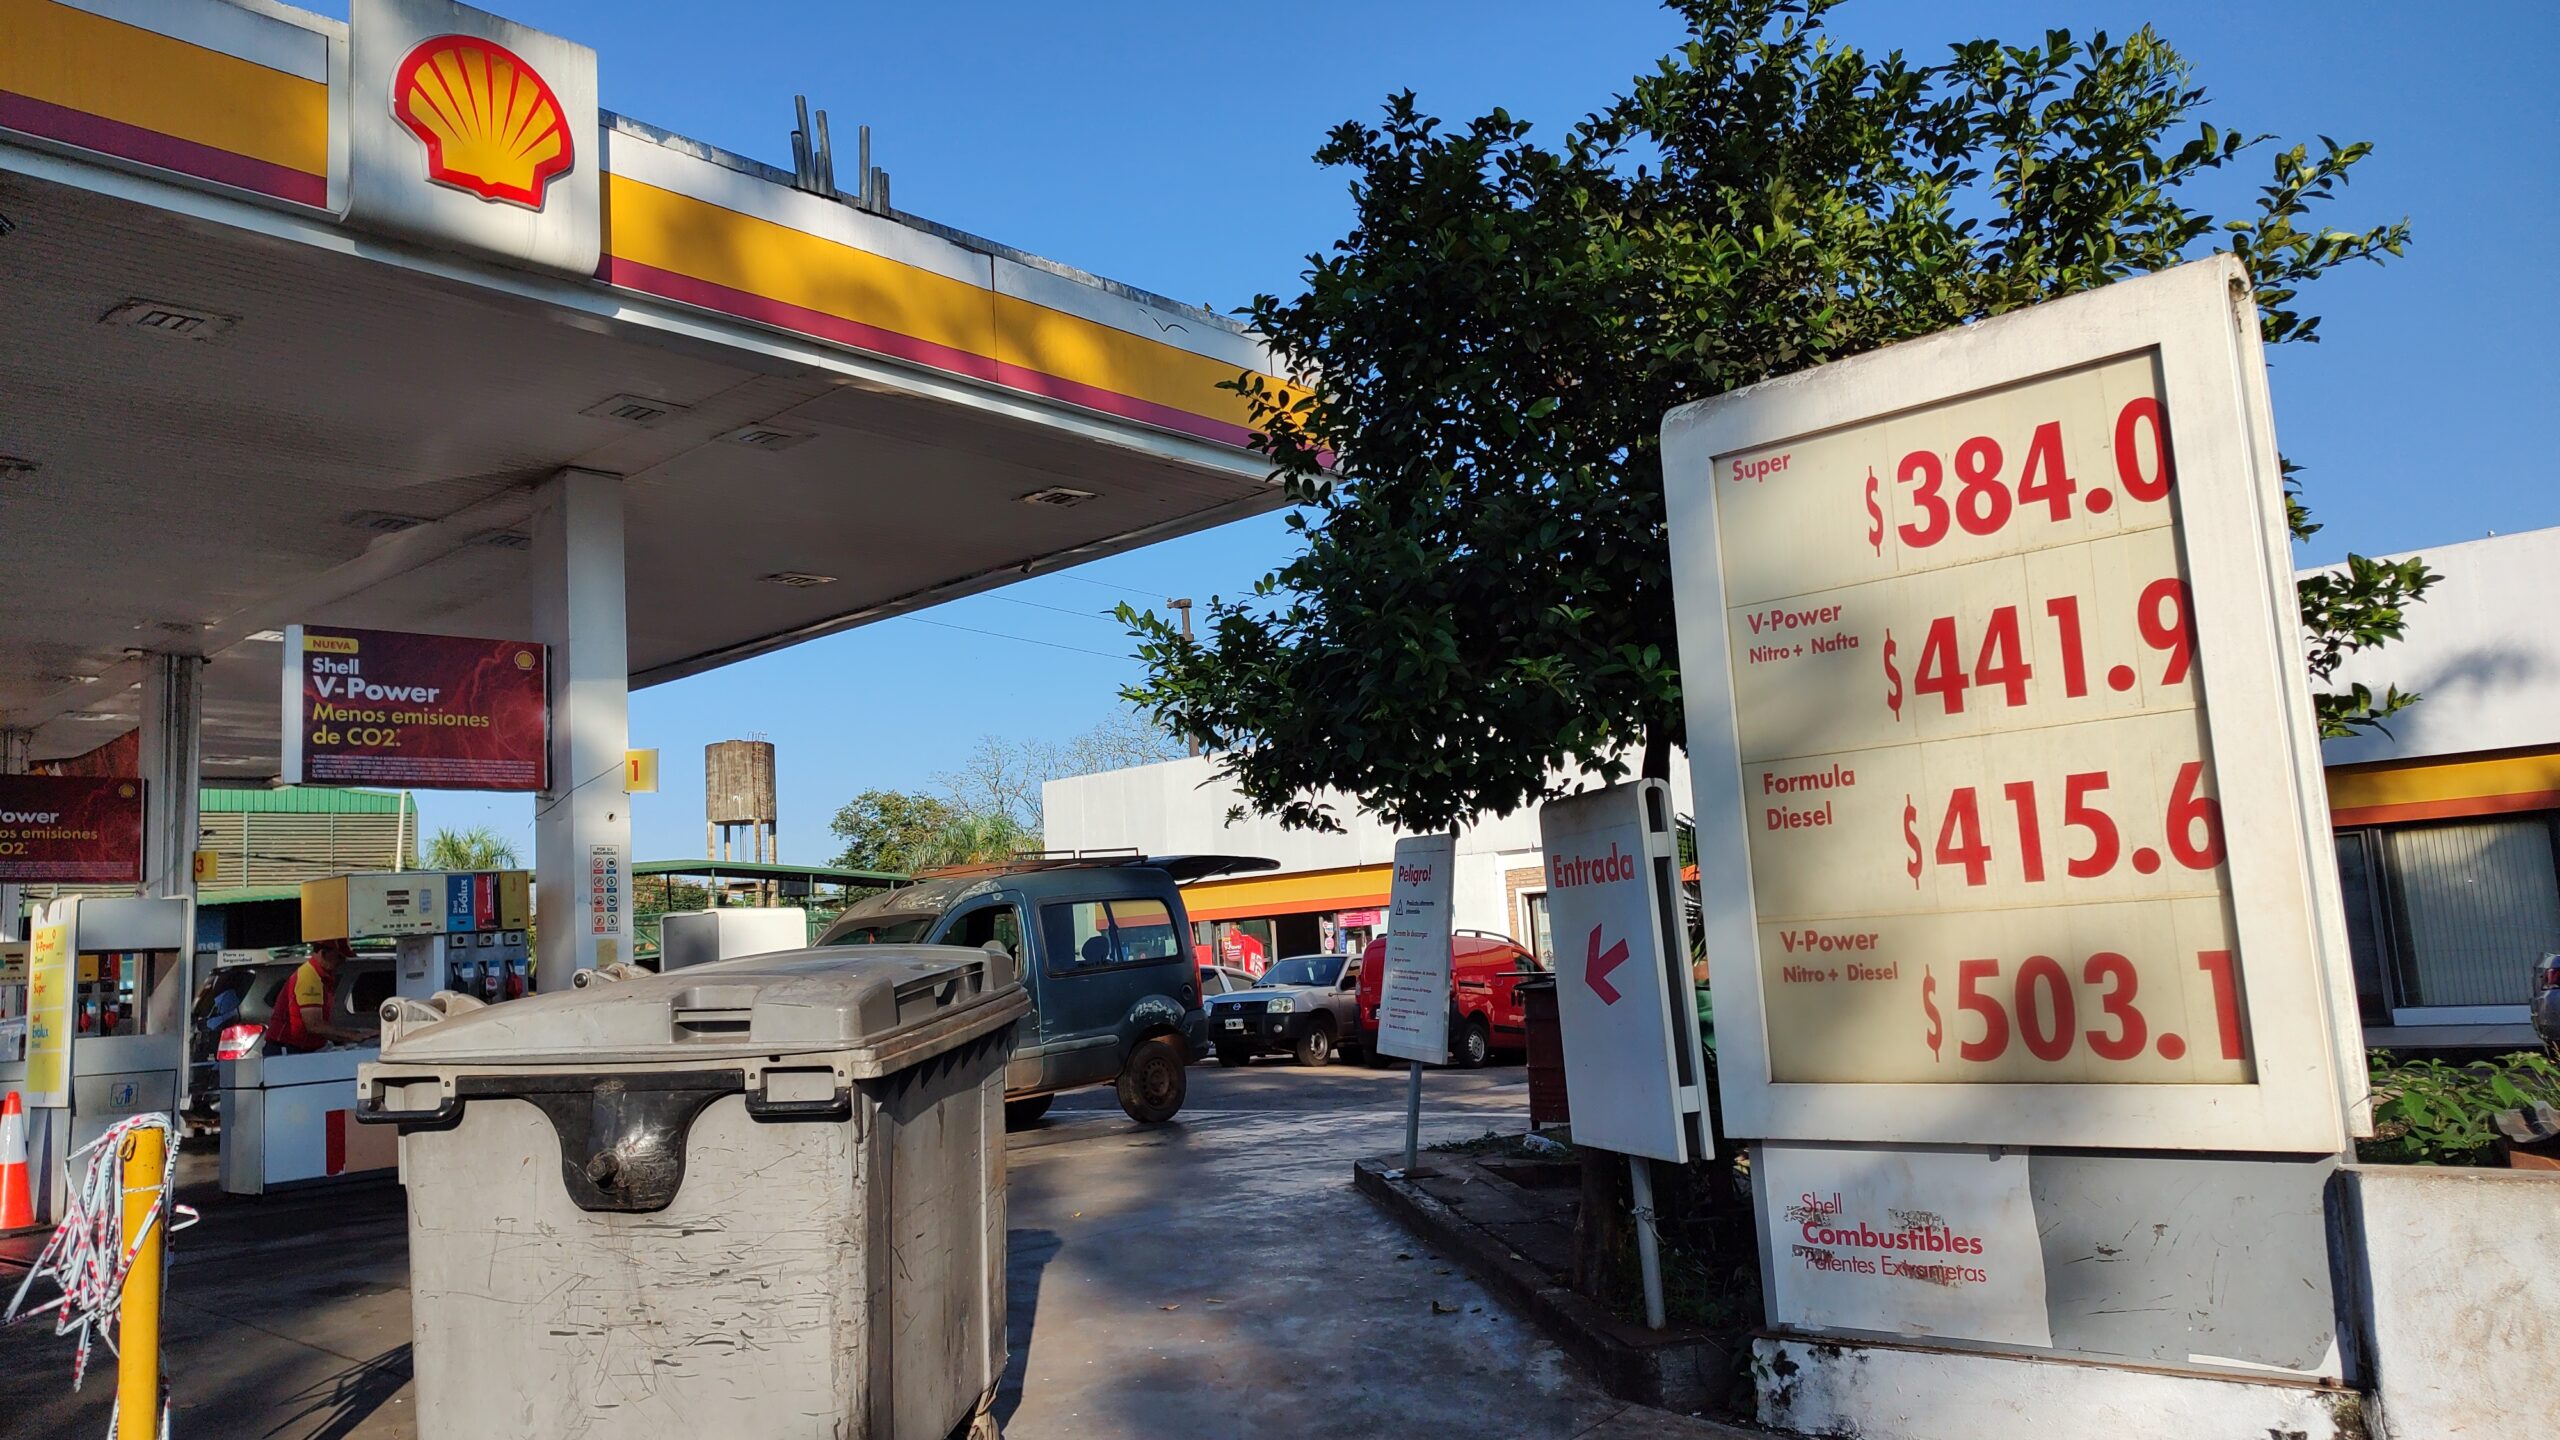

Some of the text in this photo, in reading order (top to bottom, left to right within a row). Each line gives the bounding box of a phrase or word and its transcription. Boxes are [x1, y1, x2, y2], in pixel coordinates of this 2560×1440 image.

[1732, 452, 1791, 483] Super
[1864, 396, 2176, 557] $384.0
[1747, 604, 1843, 635] V-Power
[312, 639, 351, 650] NUEVA
[1749, 633, 1860, 664] Nitro+ Nafta
[1883, 577, 2197, 722] $441.9
[312, 657, 360, 675] Shell
[312, 675, 440, 703] V-Power
[312, 703, 490, 728] Menos emisiones
[312, 725, 341, 745] de
[631, 760, 639, 782] 1
[1763, 763, 1856, 795] Formula
[0, 809, 59, 824] ower
[1766, 800, 1833, 831] Diesel
[1903, 760, 2228, 890] $415.6
[21, 826, 98, 840] emisiones
[195, 858, 204, 873] 3
[1398, 864, 1432, 887] Peligro!
[1552, 842, 1635, 888] Entrada
[35, 942, 55, 952] V-Power
[1780, 930, 1879, 953] V-Power
[1783, 961, 1899, 984] Nitro+ Diesel
[33, 983, 47, 996] Super
[1922, 949, 2246, 1063] $503.1
[1802, 1191, 1842, 1215] Shell
[1802, 1221, 1983, 1255] Combustibles
